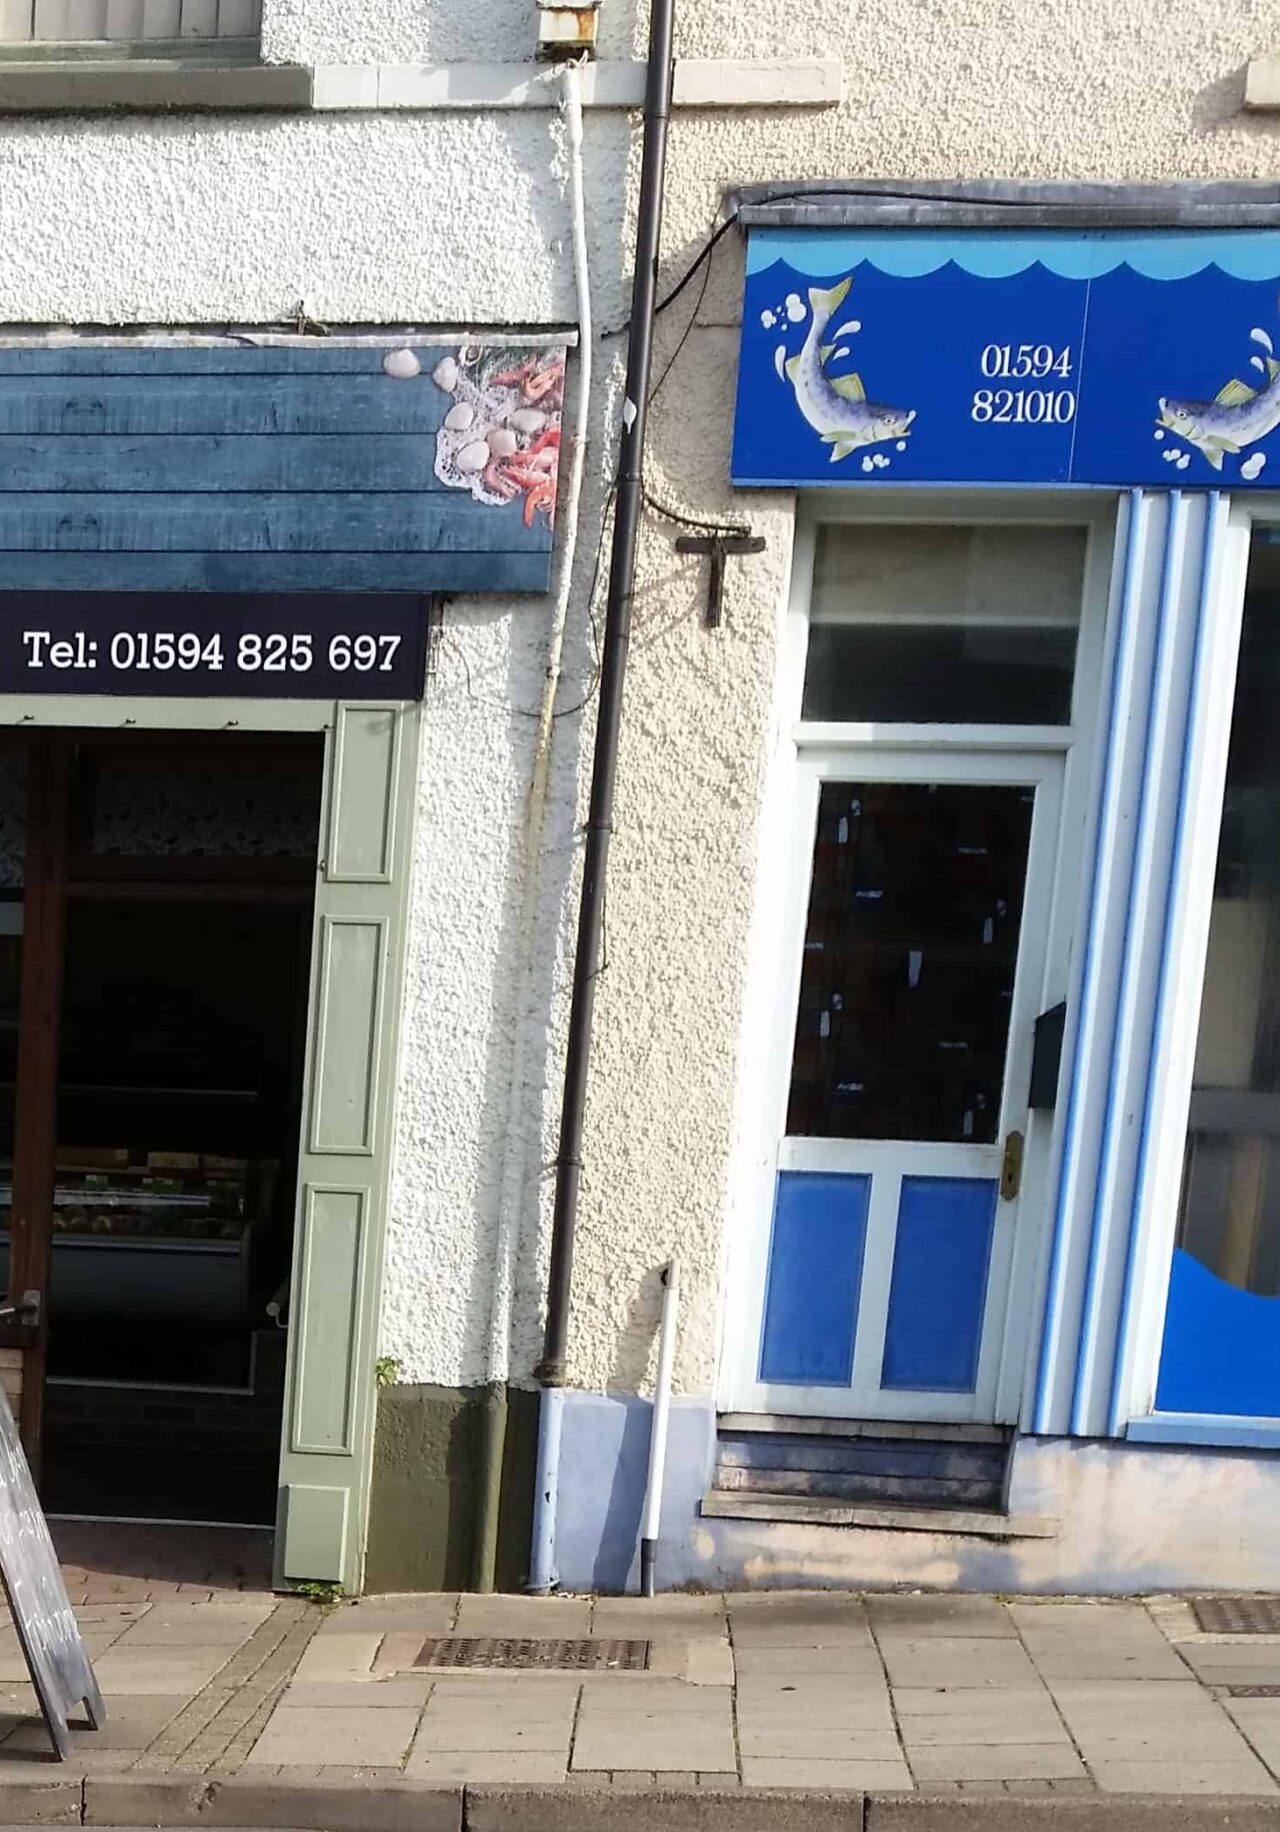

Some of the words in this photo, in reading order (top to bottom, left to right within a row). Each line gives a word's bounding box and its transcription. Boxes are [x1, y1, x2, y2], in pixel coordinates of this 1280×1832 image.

[981, 344, 1072, 378] 01594
[971, 389, 1075, 423] 821010
[22, 631, 97, 669] Tel:
[110, 632, 224, 671] 01594
[237, 634, 313, 672] 825
[328, 634, 402, 672] 697
